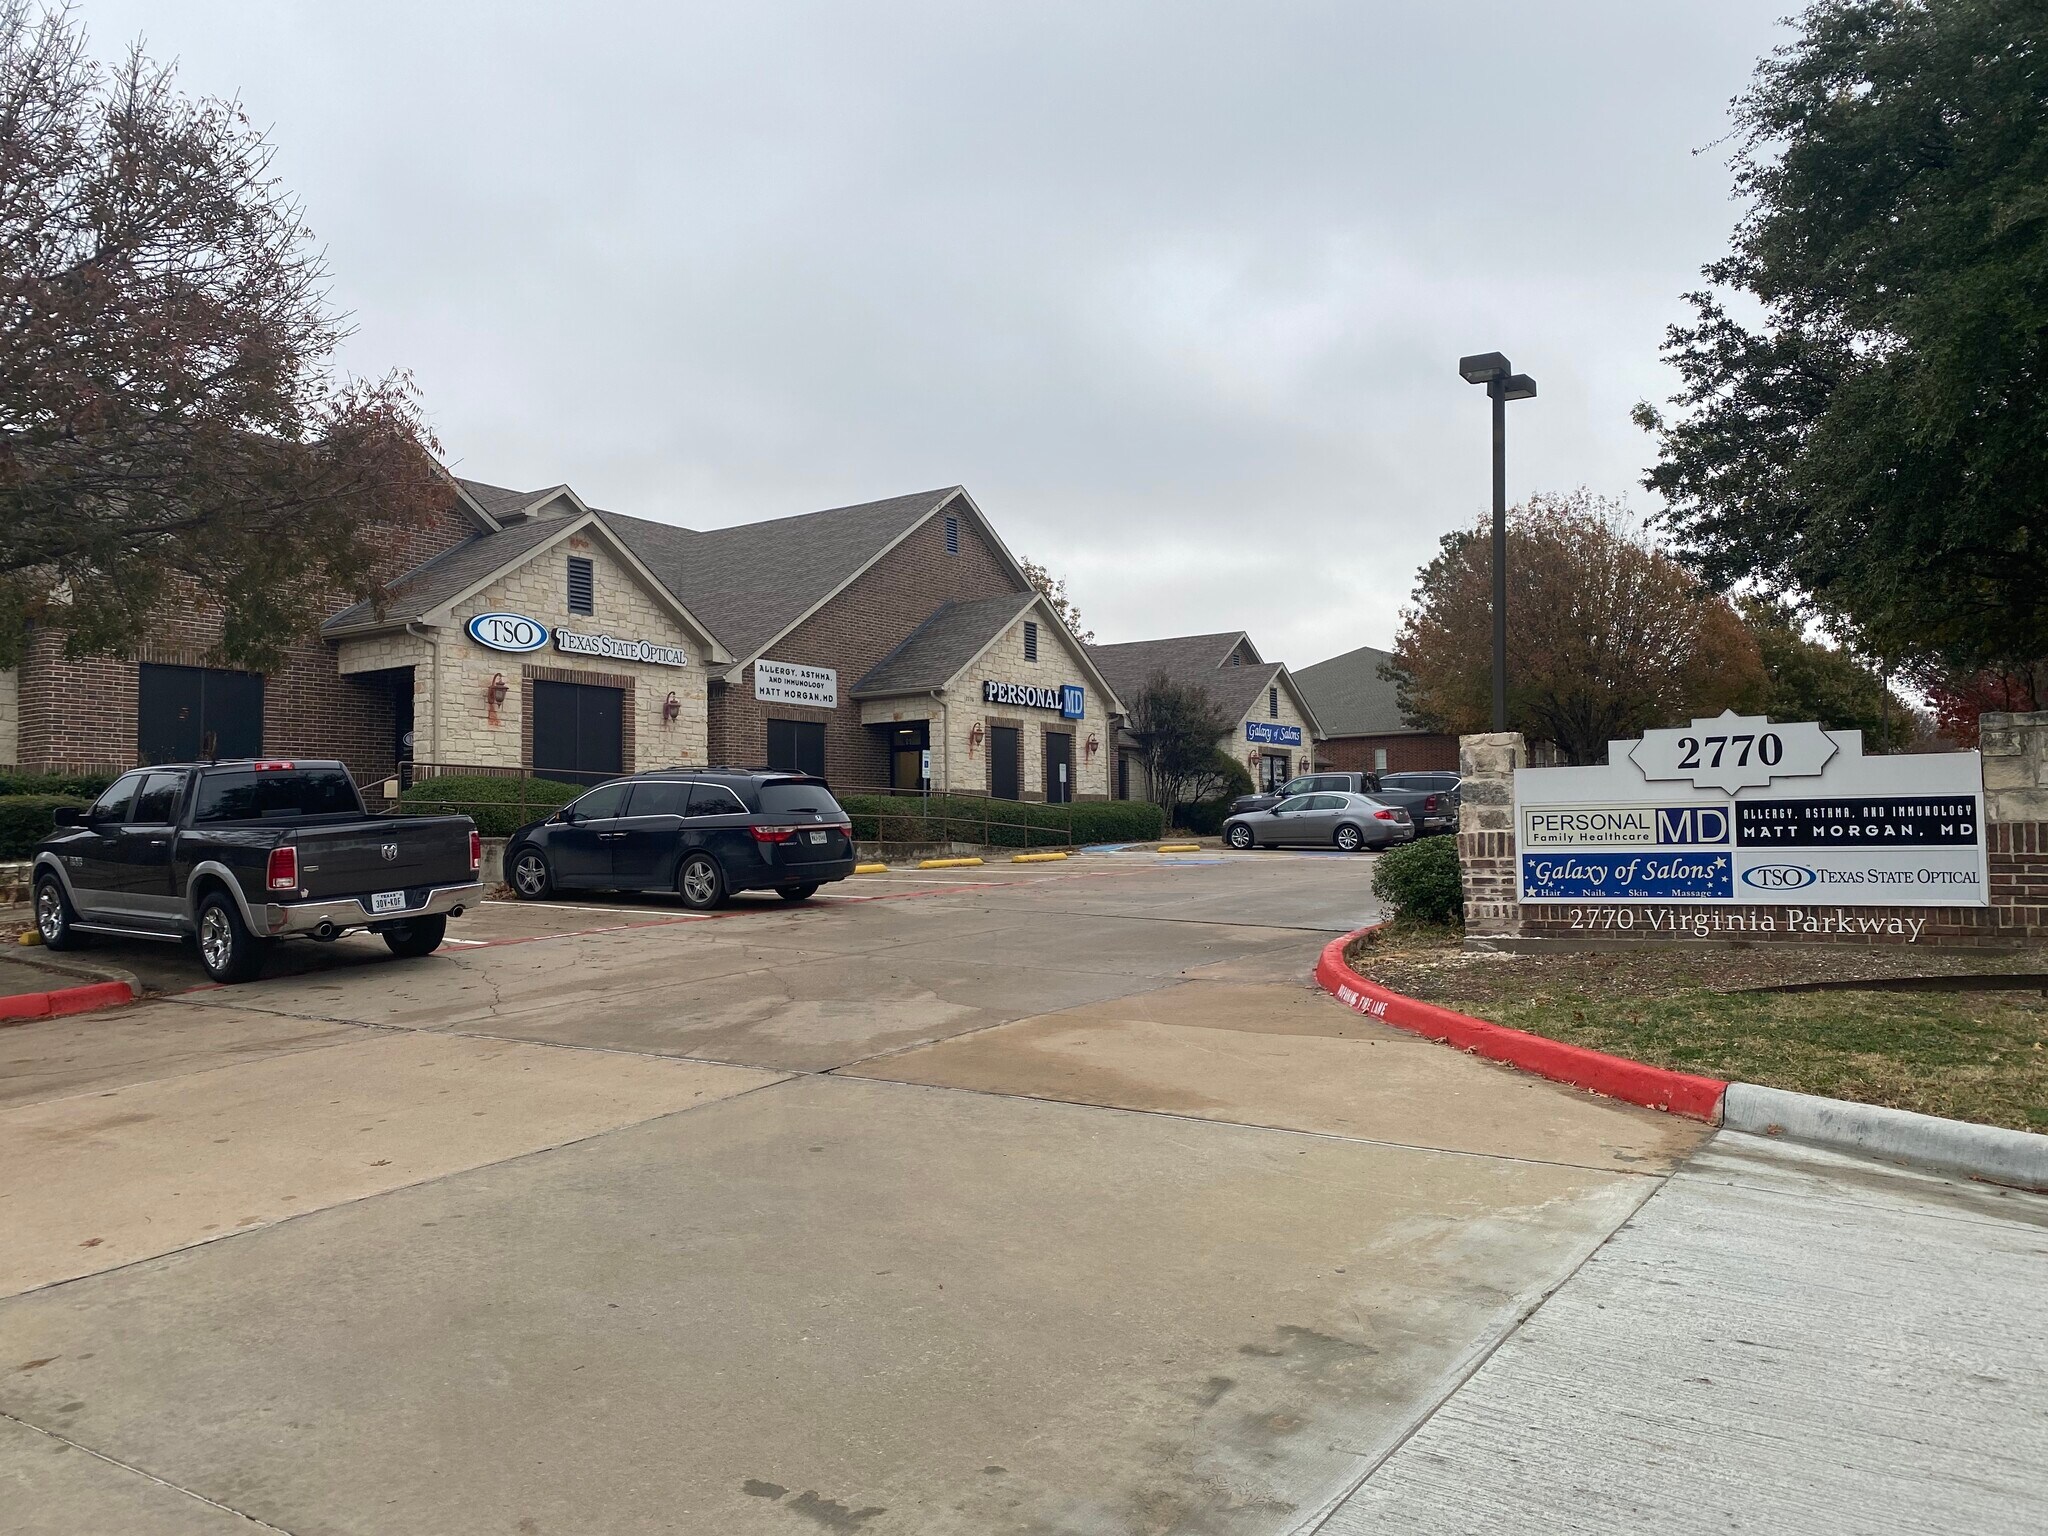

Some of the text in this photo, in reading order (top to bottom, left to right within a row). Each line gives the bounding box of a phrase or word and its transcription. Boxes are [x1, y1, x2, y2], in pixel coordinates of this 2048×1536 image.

[488, 619, 533, 645] TSO
[558, 630, 686, 664] TEXAS STATE OPTICAL
[759, 686, 781, 696] MATT
[768, 676, 825, 689] AND IMMUNOLOGY
[988, 681, 1083, 714] PERSONAL MD
[1249, 722, 1300, 743] Galaxy of Salons
[1677, 733, 1783, 769] 2770
[1743, 804, 1972, 820] ALLERGY, ASTHMA, AND IMMUNOLOGY
[1532, 809, 1728, 843] PERSONAL MD
[1743, 823, 1973, 838] MATT MORGAN, MD
[1533, 832, 1650, 843] Family Healthcare
[1535, 858, 1716, 885] Galaxy of Salons
[1757, 868, 1803, 887] TSO
[1816, 868, 1981, 884] TEXAS STATE OPTICAL
[1540, 888, 1712, 898] Hair Nails Skin Massage
[1570, 908, 1926, 942] 2770 Virginia Parkway
